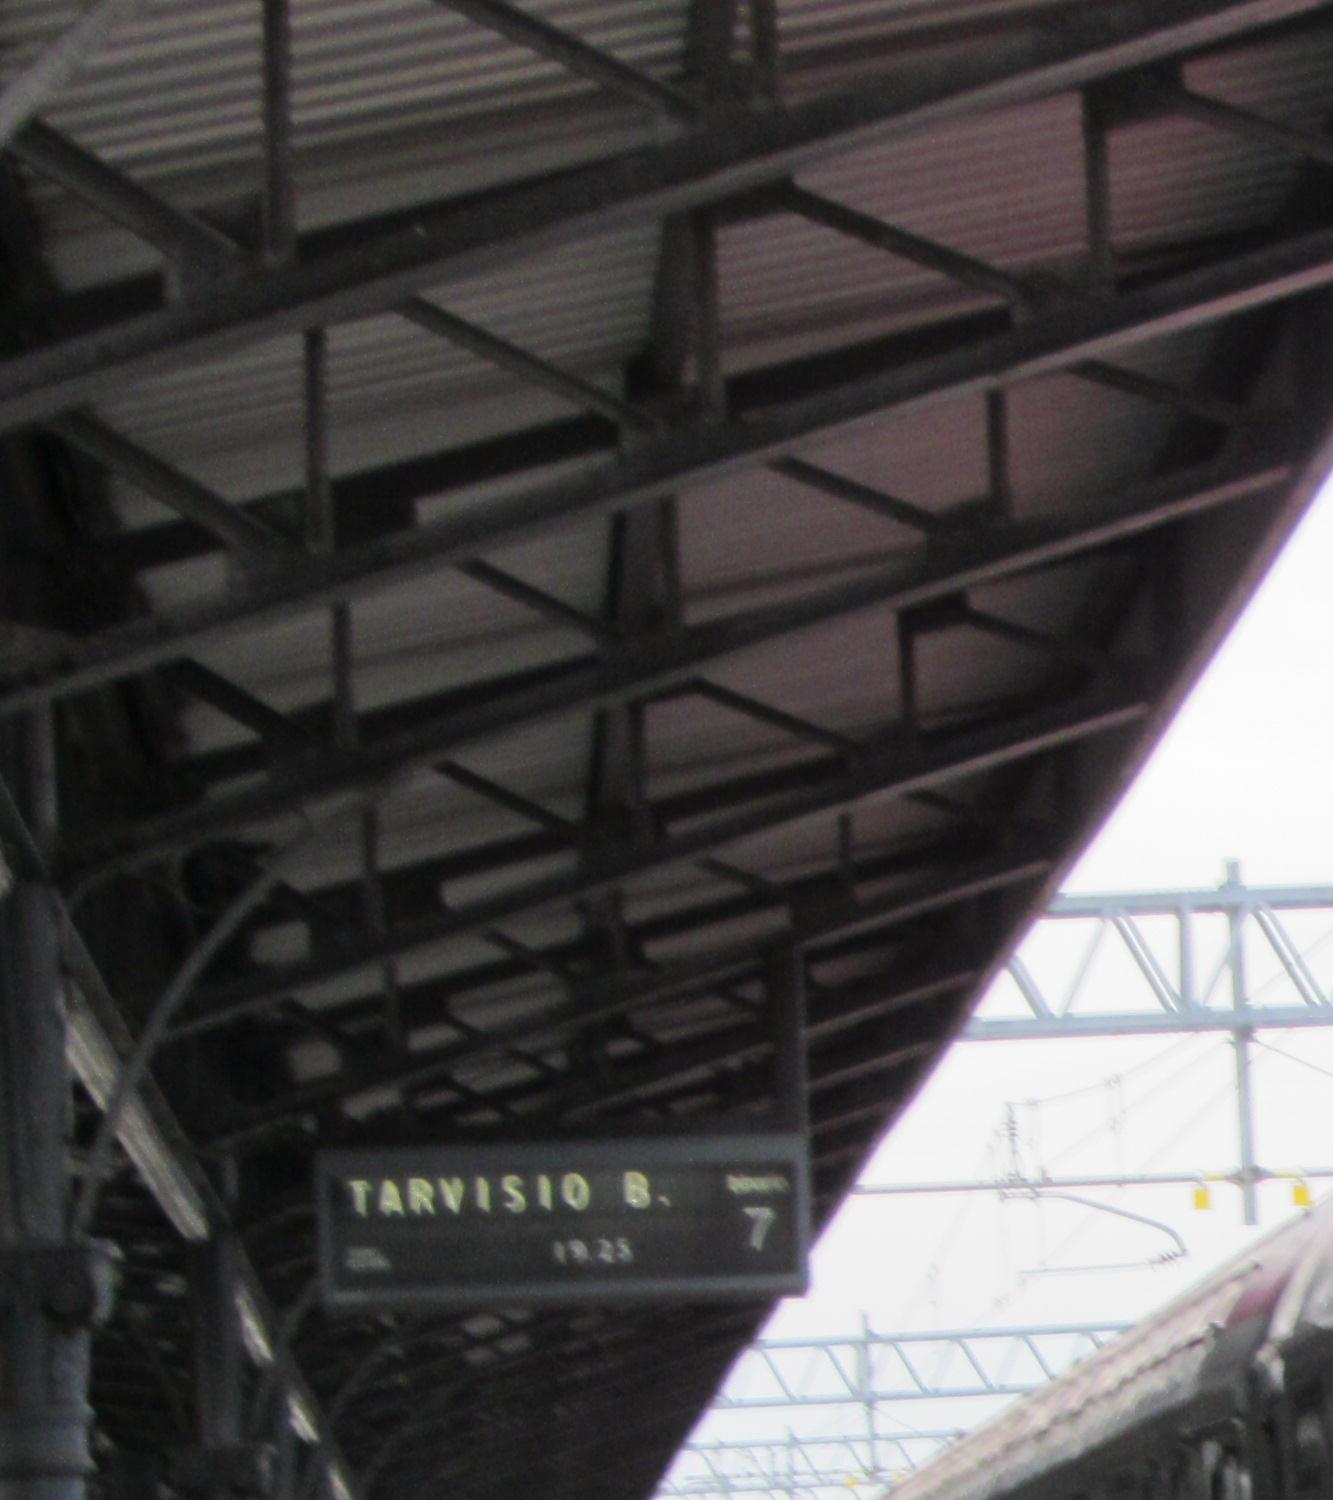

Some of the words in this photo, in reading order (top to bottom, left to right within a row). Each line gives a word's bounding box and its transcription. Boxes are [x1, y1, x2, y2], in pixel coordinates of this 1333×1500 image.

[349, 1173, 591, 1217] TARVISIO
[623, 1171, 671, 1209] B.
[743, 1206, 776, 1252] 7
